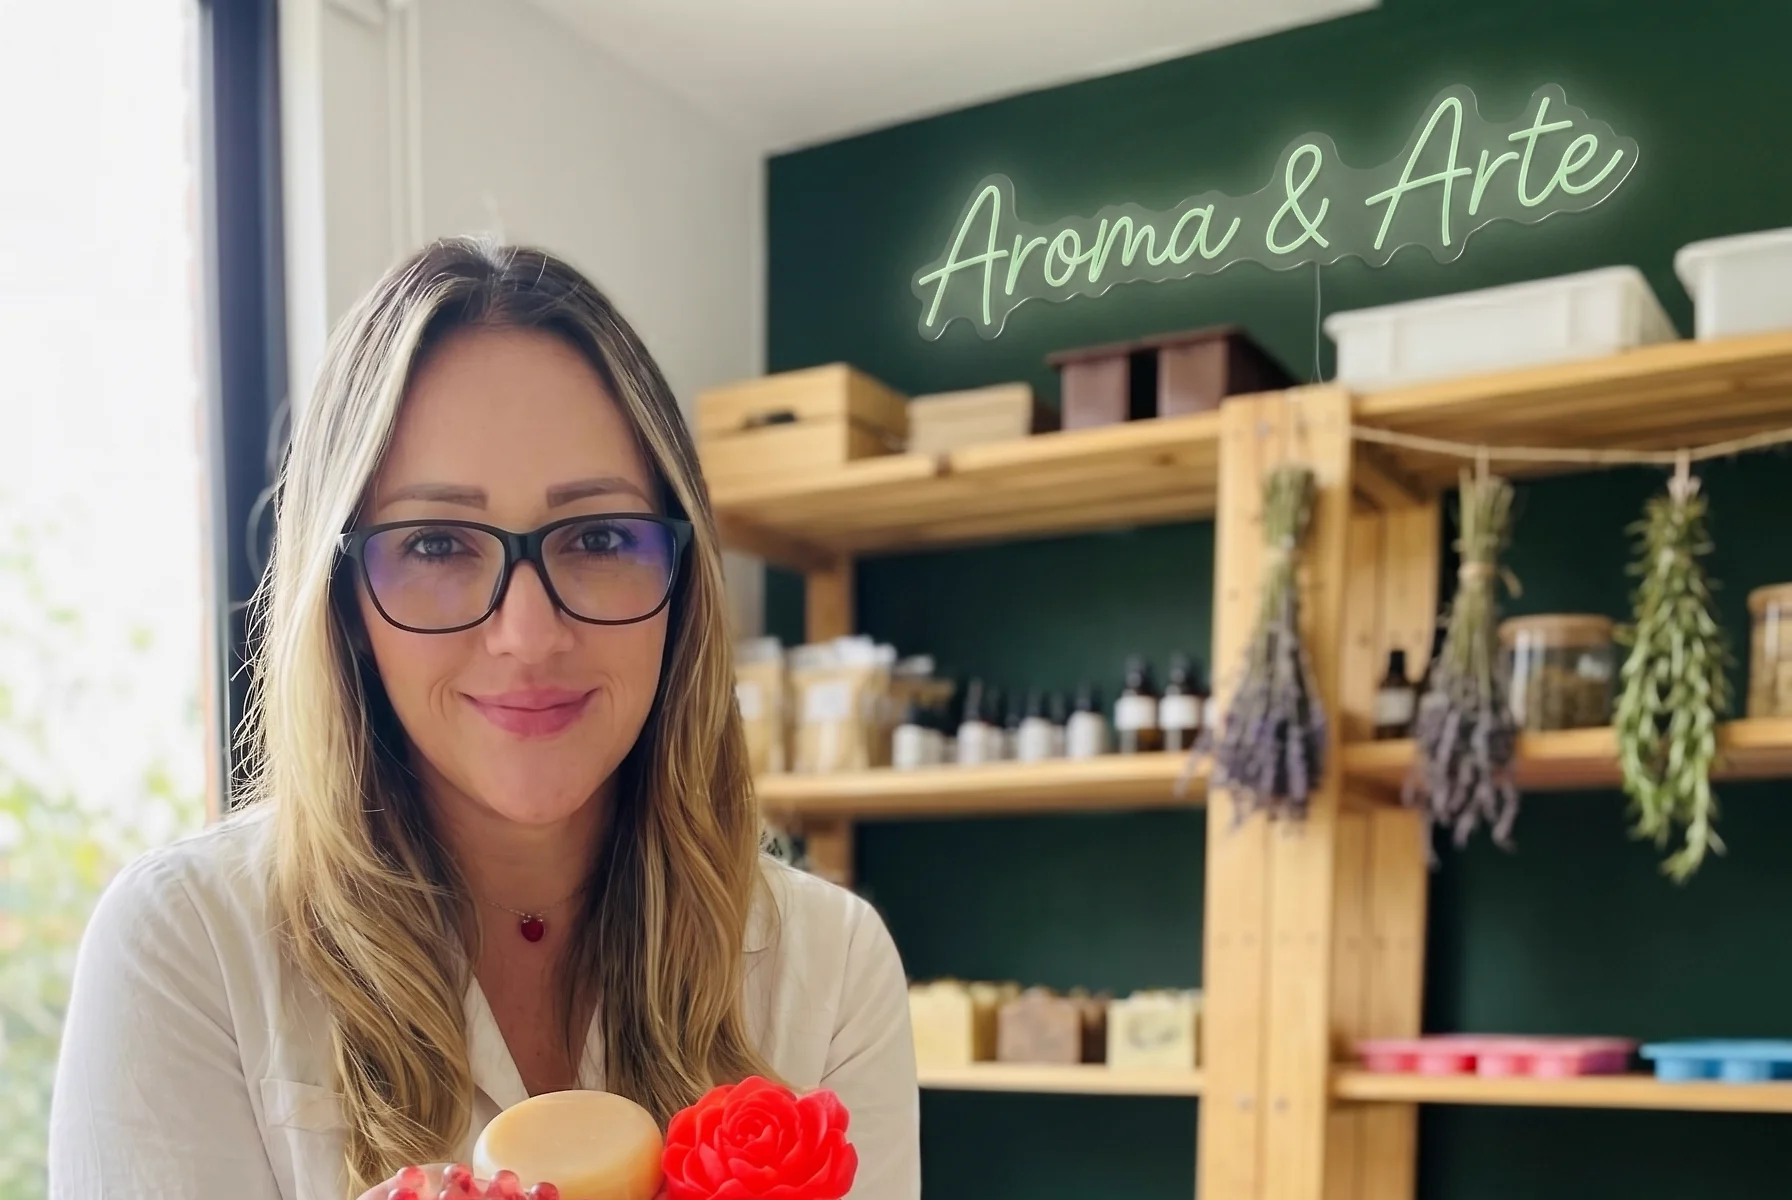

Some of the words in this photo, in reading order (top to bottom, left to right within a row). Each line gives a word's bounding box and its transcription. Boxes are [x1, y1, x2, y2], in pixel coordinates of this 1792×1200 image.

[918, 184, 1241, 327] Aroma
[1264, 143, 1330, 255] &
[1365, 96, 1624, 250] Arte
